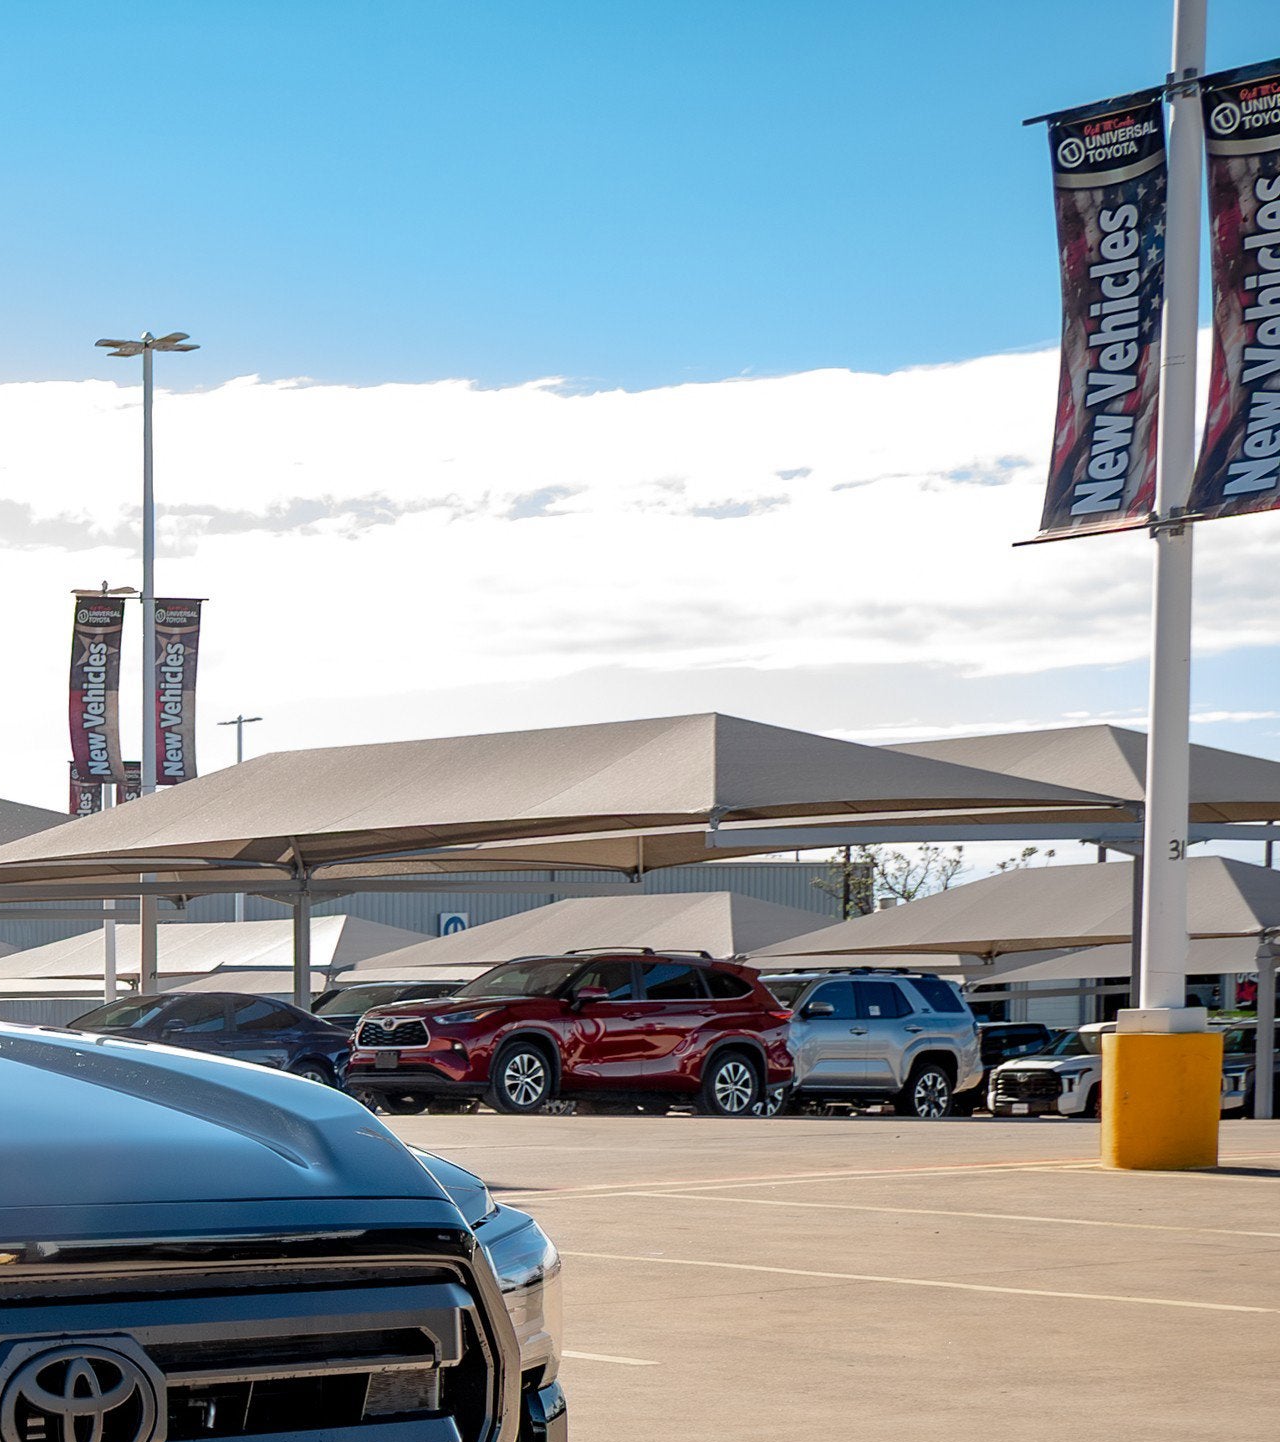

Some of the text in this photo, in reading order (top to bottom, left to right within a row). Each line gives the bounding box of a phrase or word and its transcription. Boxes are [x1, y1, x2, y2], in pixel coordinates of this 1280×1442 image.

[1085, 119, 1159, 149] UNIVERSAL
[1085, 142, 1138, 164] TOYOTA
[1070, 203, 1140, 516] New Vehicles
[1222, 176, 1280, 496] New Vehicles
[82, 642, 112, 776] New Vehicles
[159, 642, 186, 777] New Vehicles
